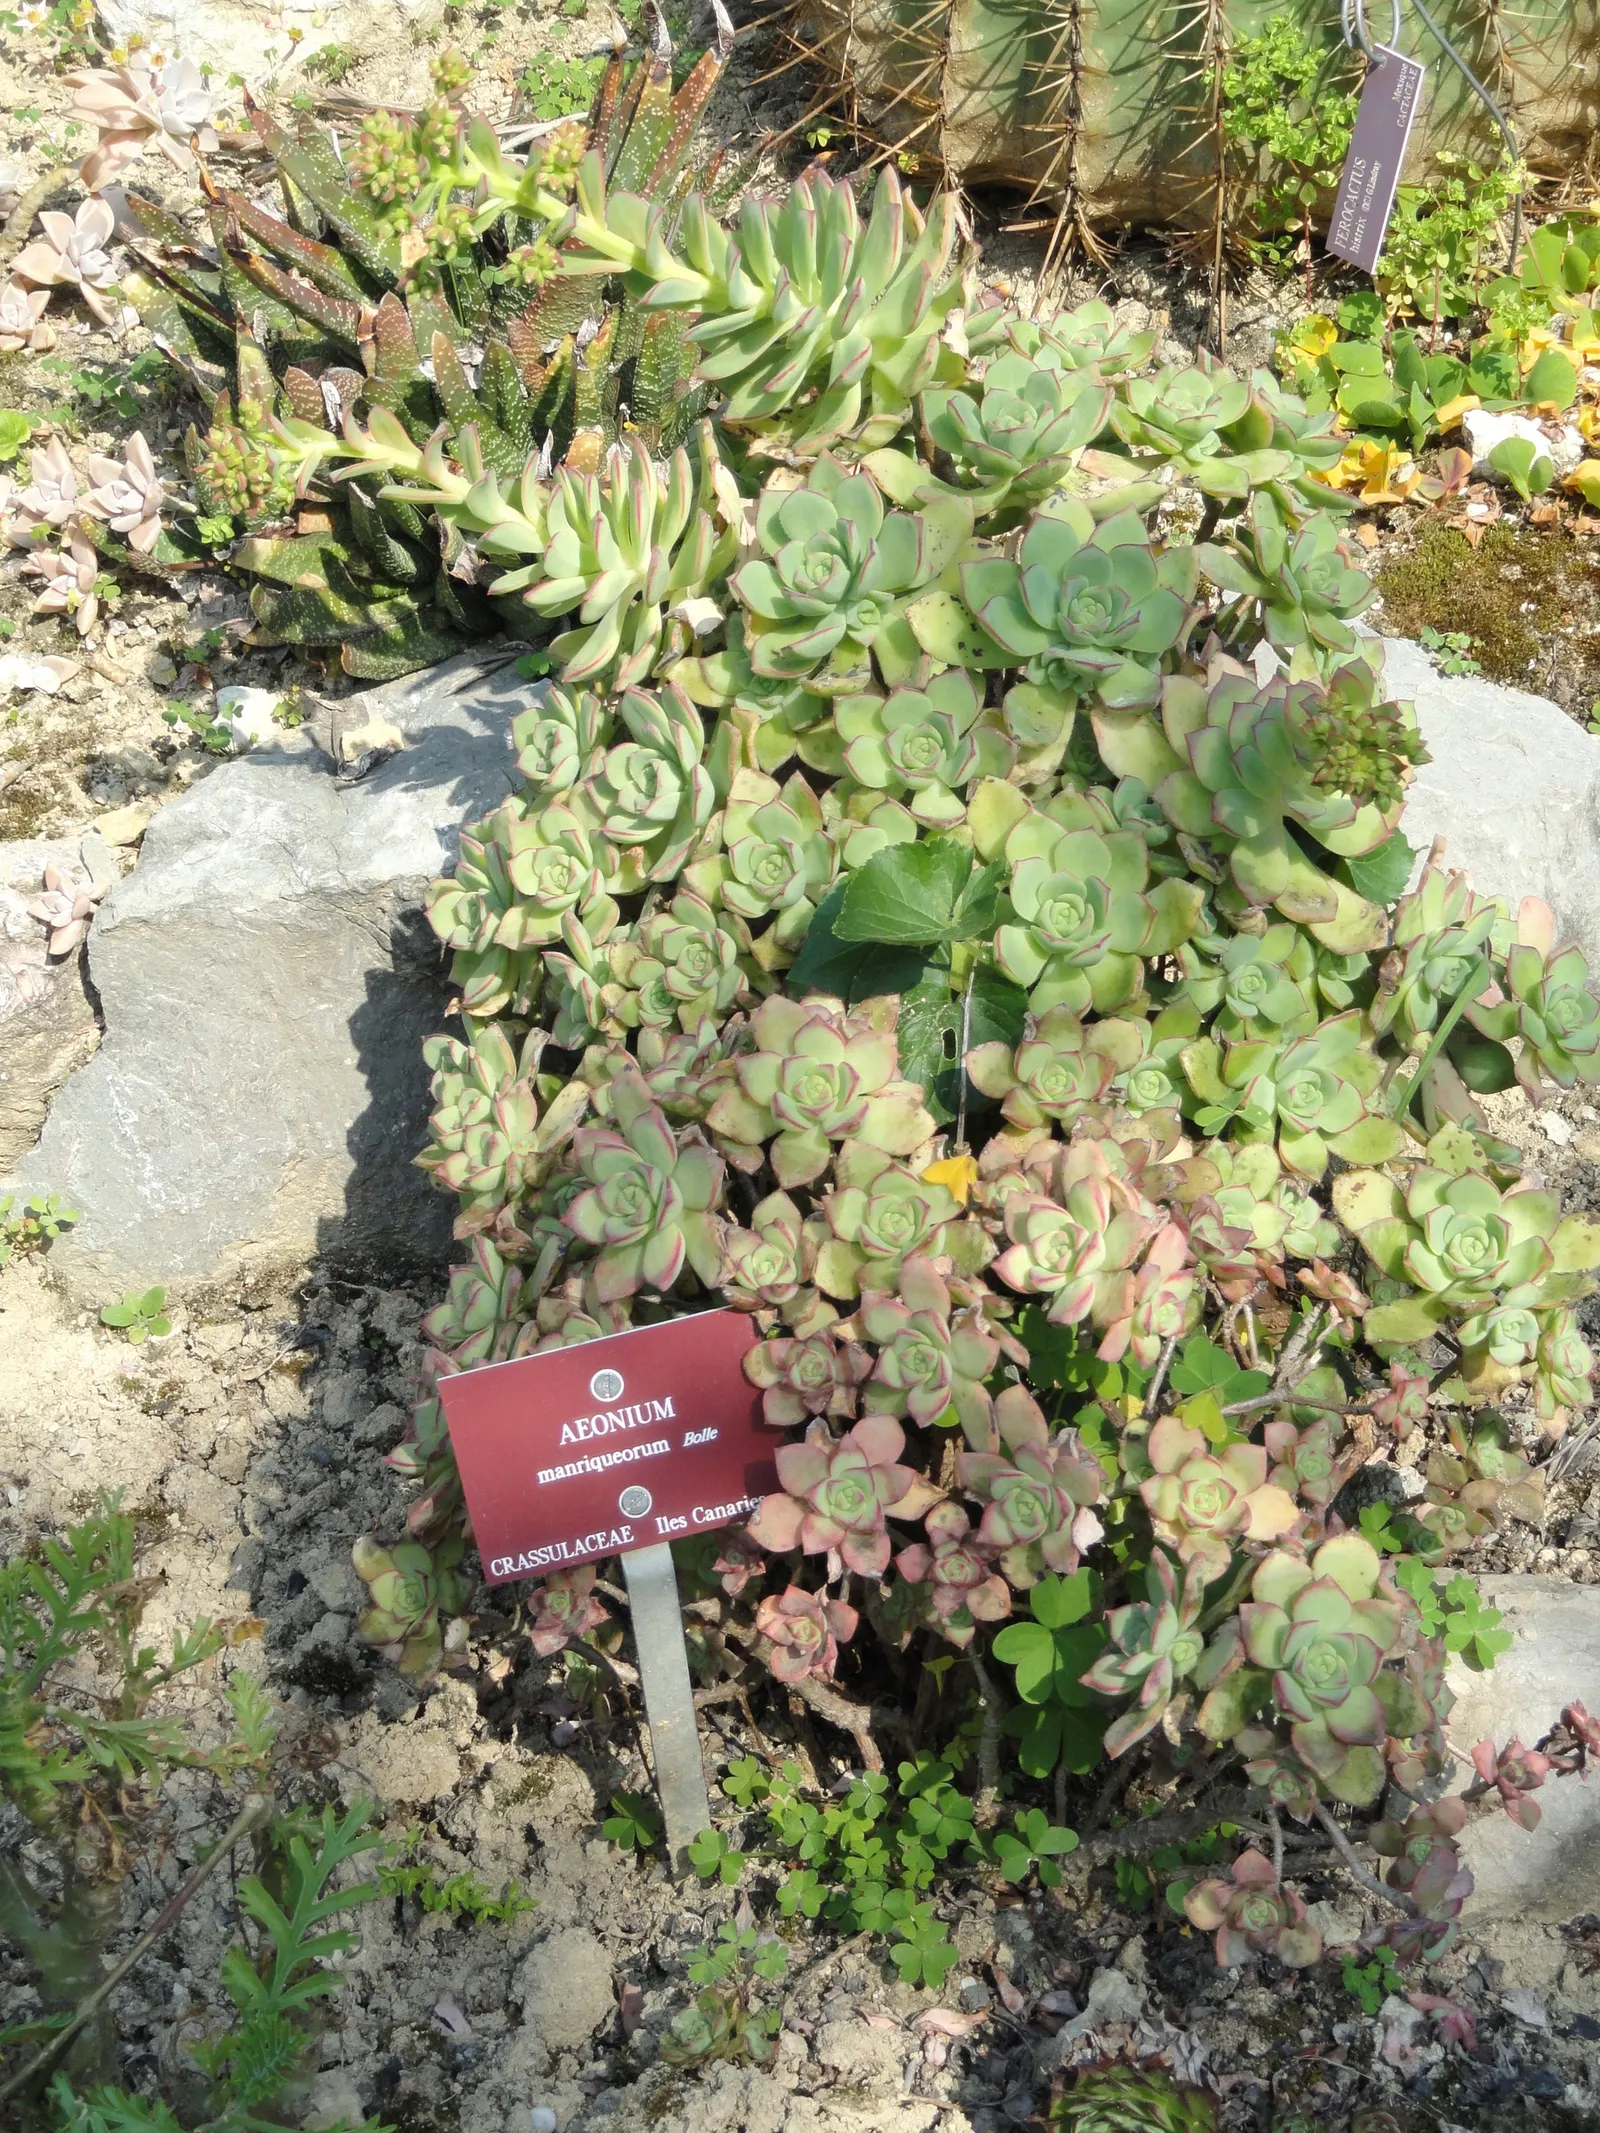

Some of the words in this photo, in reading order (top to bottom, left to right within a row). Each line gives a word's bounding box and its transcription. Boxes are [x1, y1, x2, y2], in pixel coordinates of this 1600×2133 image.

[1392, 63, 1408, 102] Mexique
[1397, 68, 1418, 128] CACTACEAE
[1334, 158, 1367, 248] FEROCACTUS
[1350, 217, 1367, 254] histrix
[559, 1397, 676, 1446] AEONIUM
[537, 1438, 671, 1484] manriqueorum
[683, 1427, 718, 1447] Bolle
[655, 1515, 688, 1535] Iles
[491, 1526, 635, 1577] CRASSULACEAE
